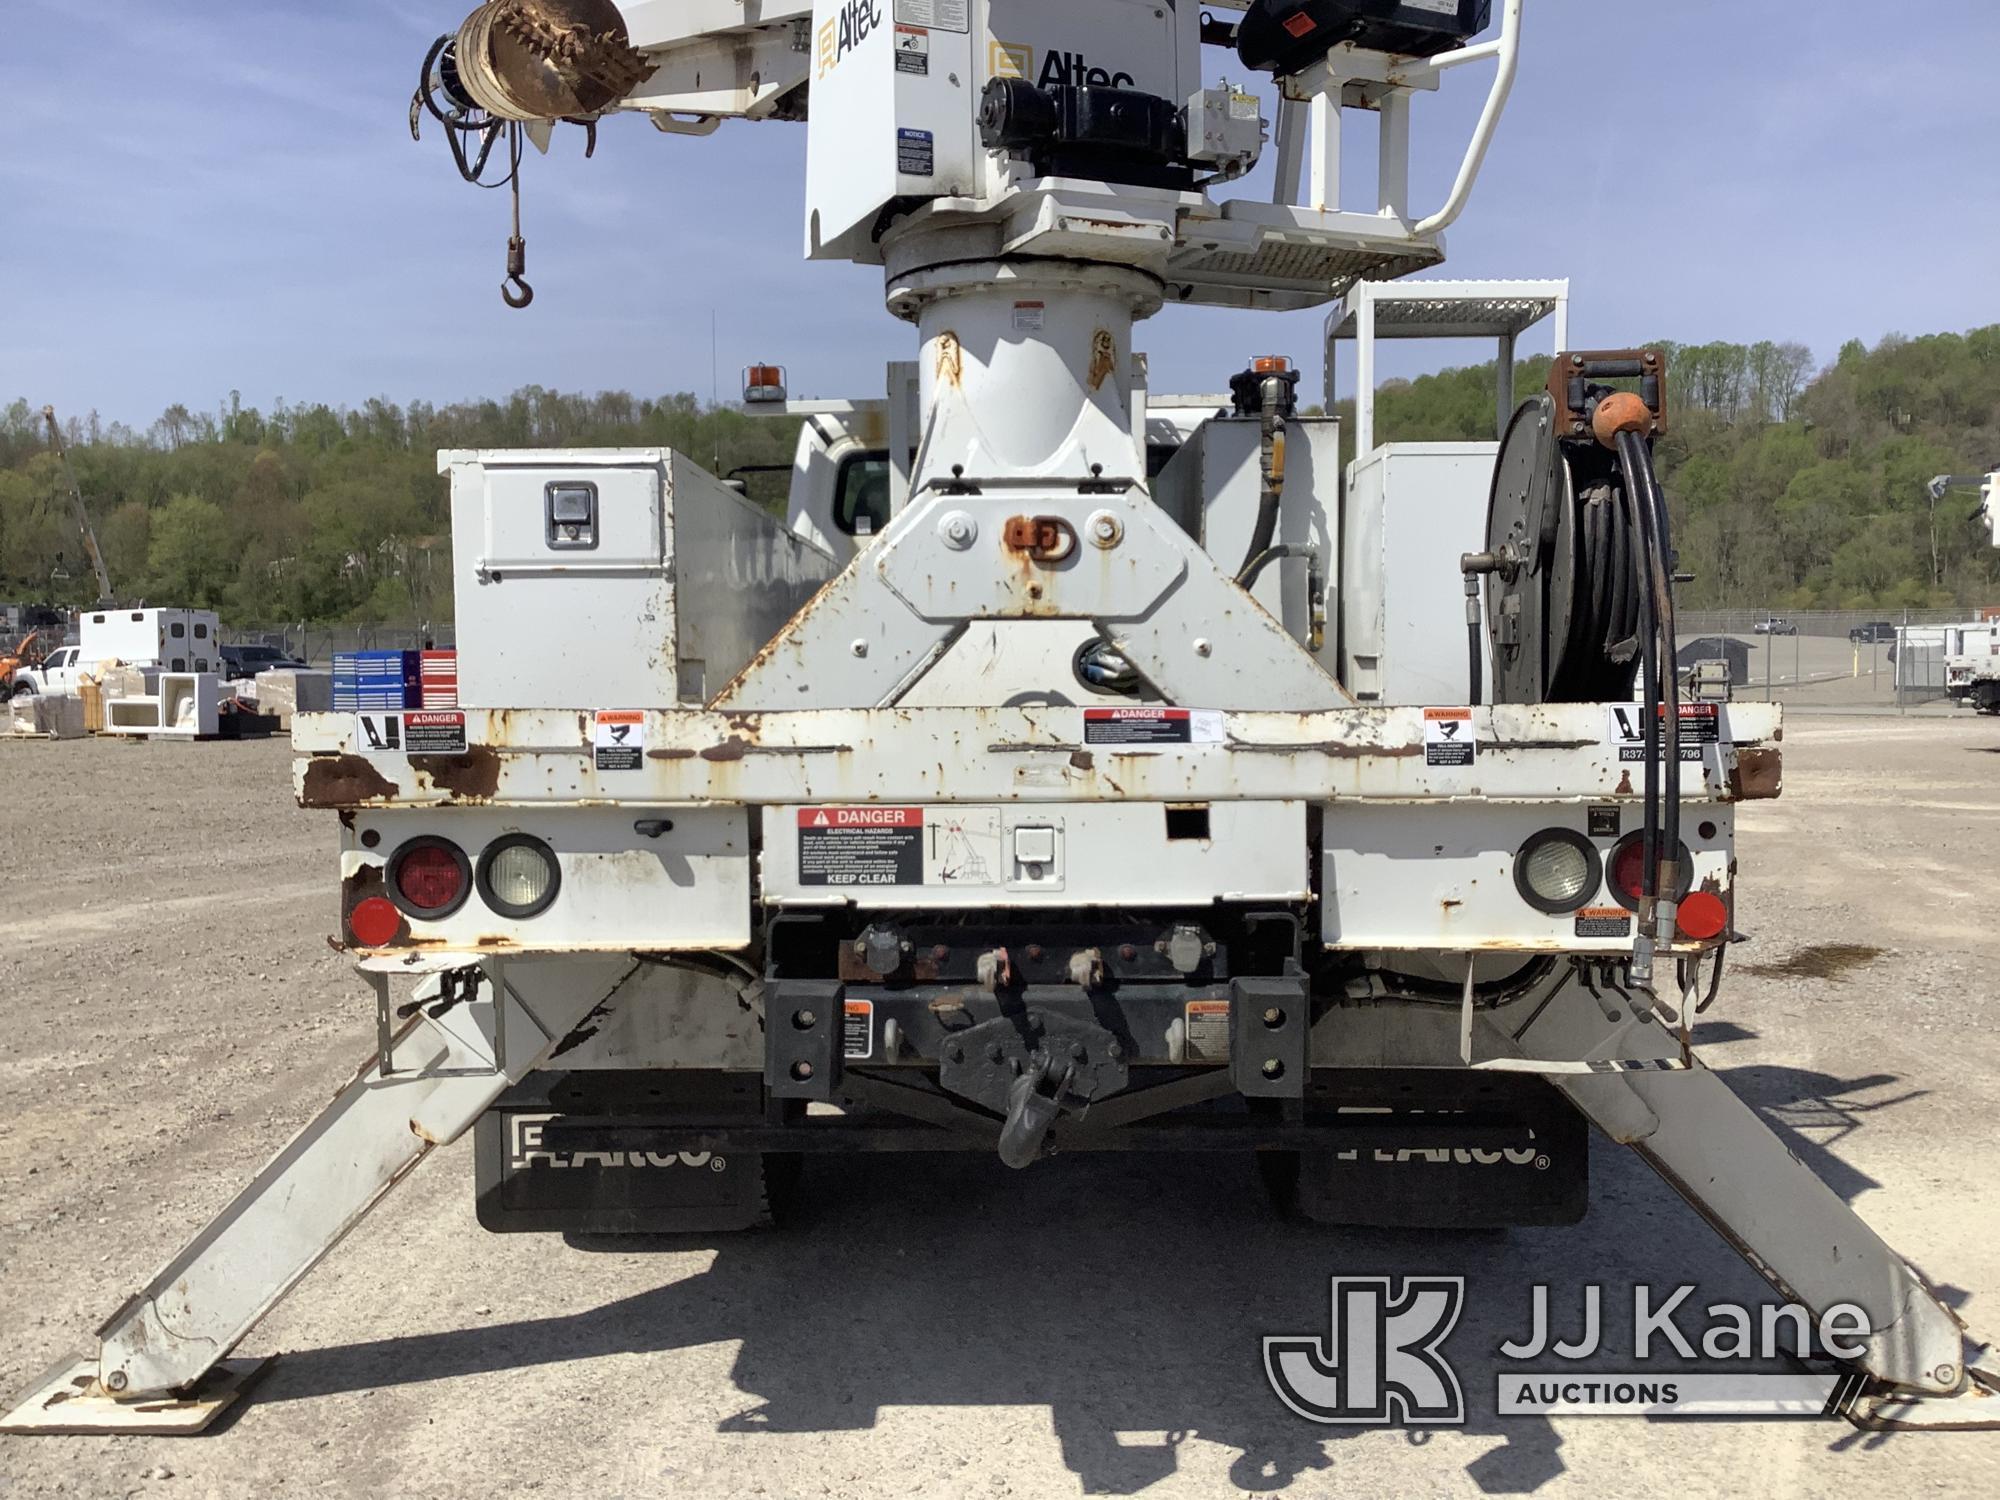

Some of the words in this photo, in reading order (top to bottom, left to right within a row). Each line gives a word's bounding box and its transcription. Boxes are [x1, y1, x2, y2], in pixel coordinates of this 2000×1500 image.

[421, 714, 458, 723] DANGER
[1121, 709, 1166, 719] DANGER
[837, 810, 906, 824] DANGER
[827, 874, 857, 884] KEEP
[858, 874, 896, 884] CLEAR
